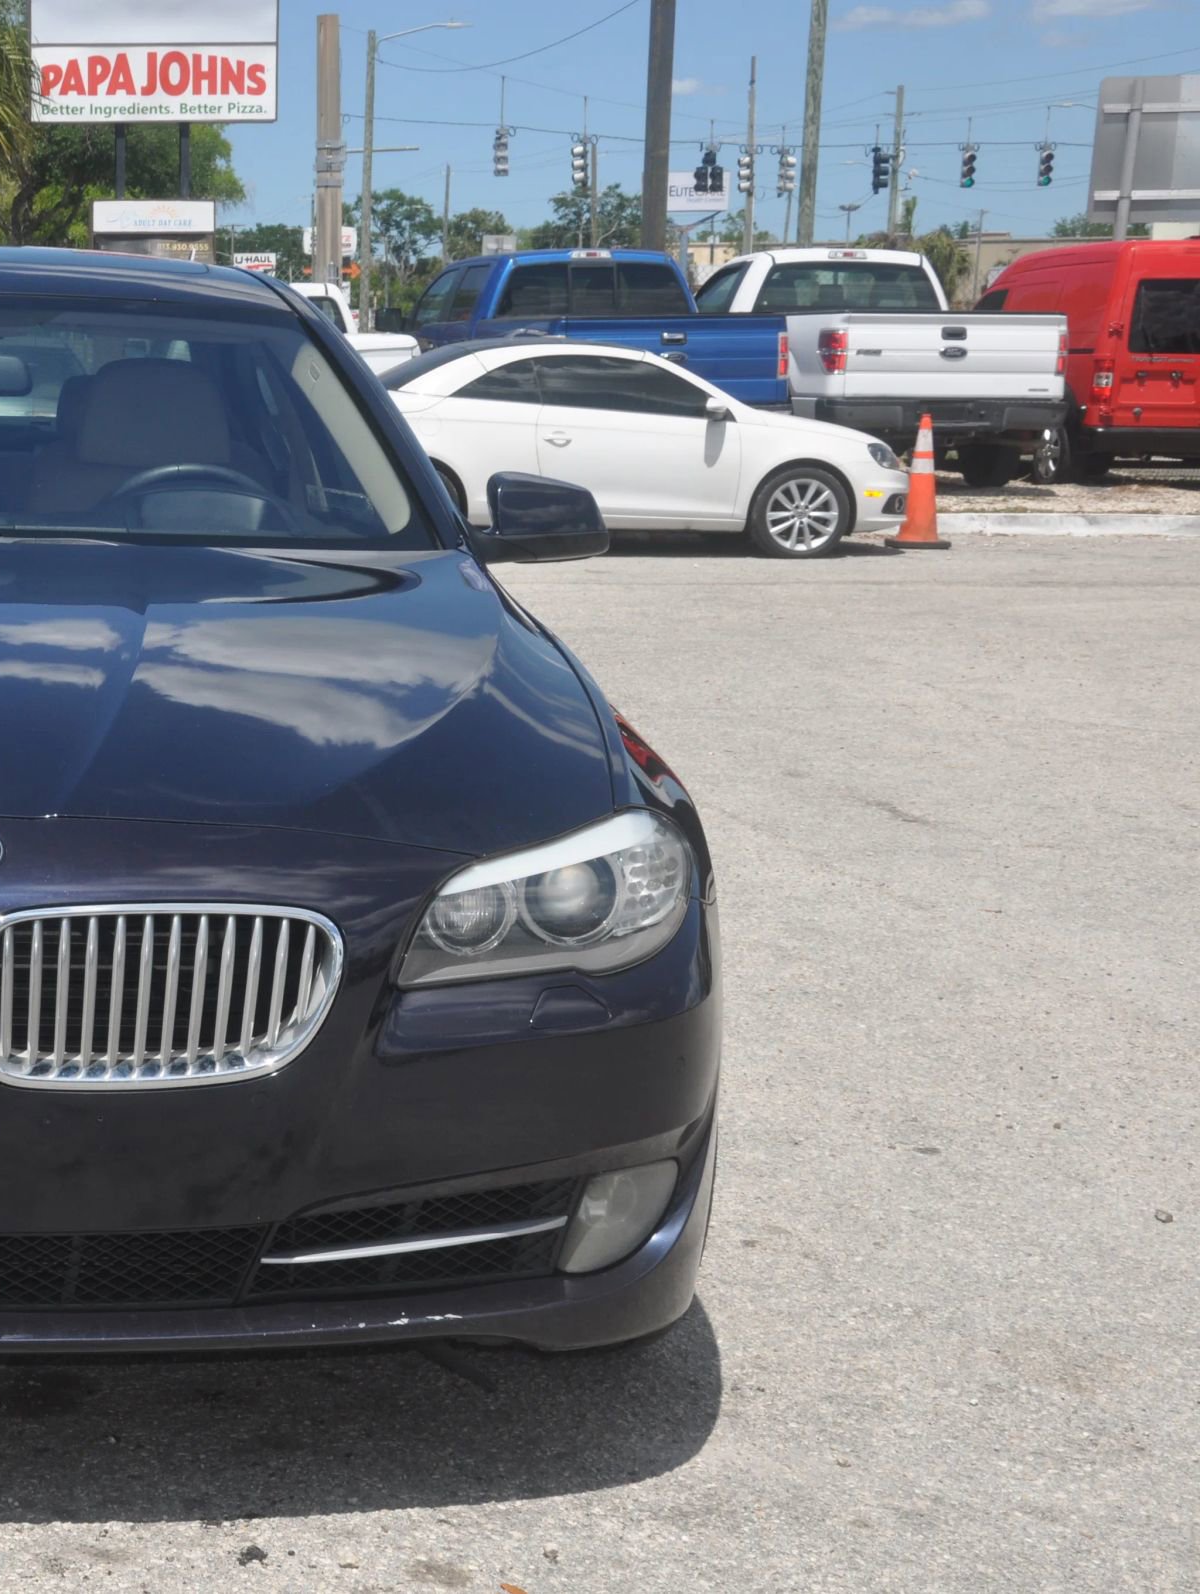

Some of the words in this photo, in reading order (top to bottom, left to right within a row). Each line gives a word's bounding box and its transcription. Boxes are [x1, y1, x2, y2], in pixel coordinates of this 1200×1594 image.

[40, 53, 137, 96] PAPA
[141, 51, 267, 96] JOHNS
[41, 103, 85, 116] Better
[90, 103, 174, 118] Ingredients.
[179, 102, 222, 115] Better
[227, 101, 267, 114] Pizza.
